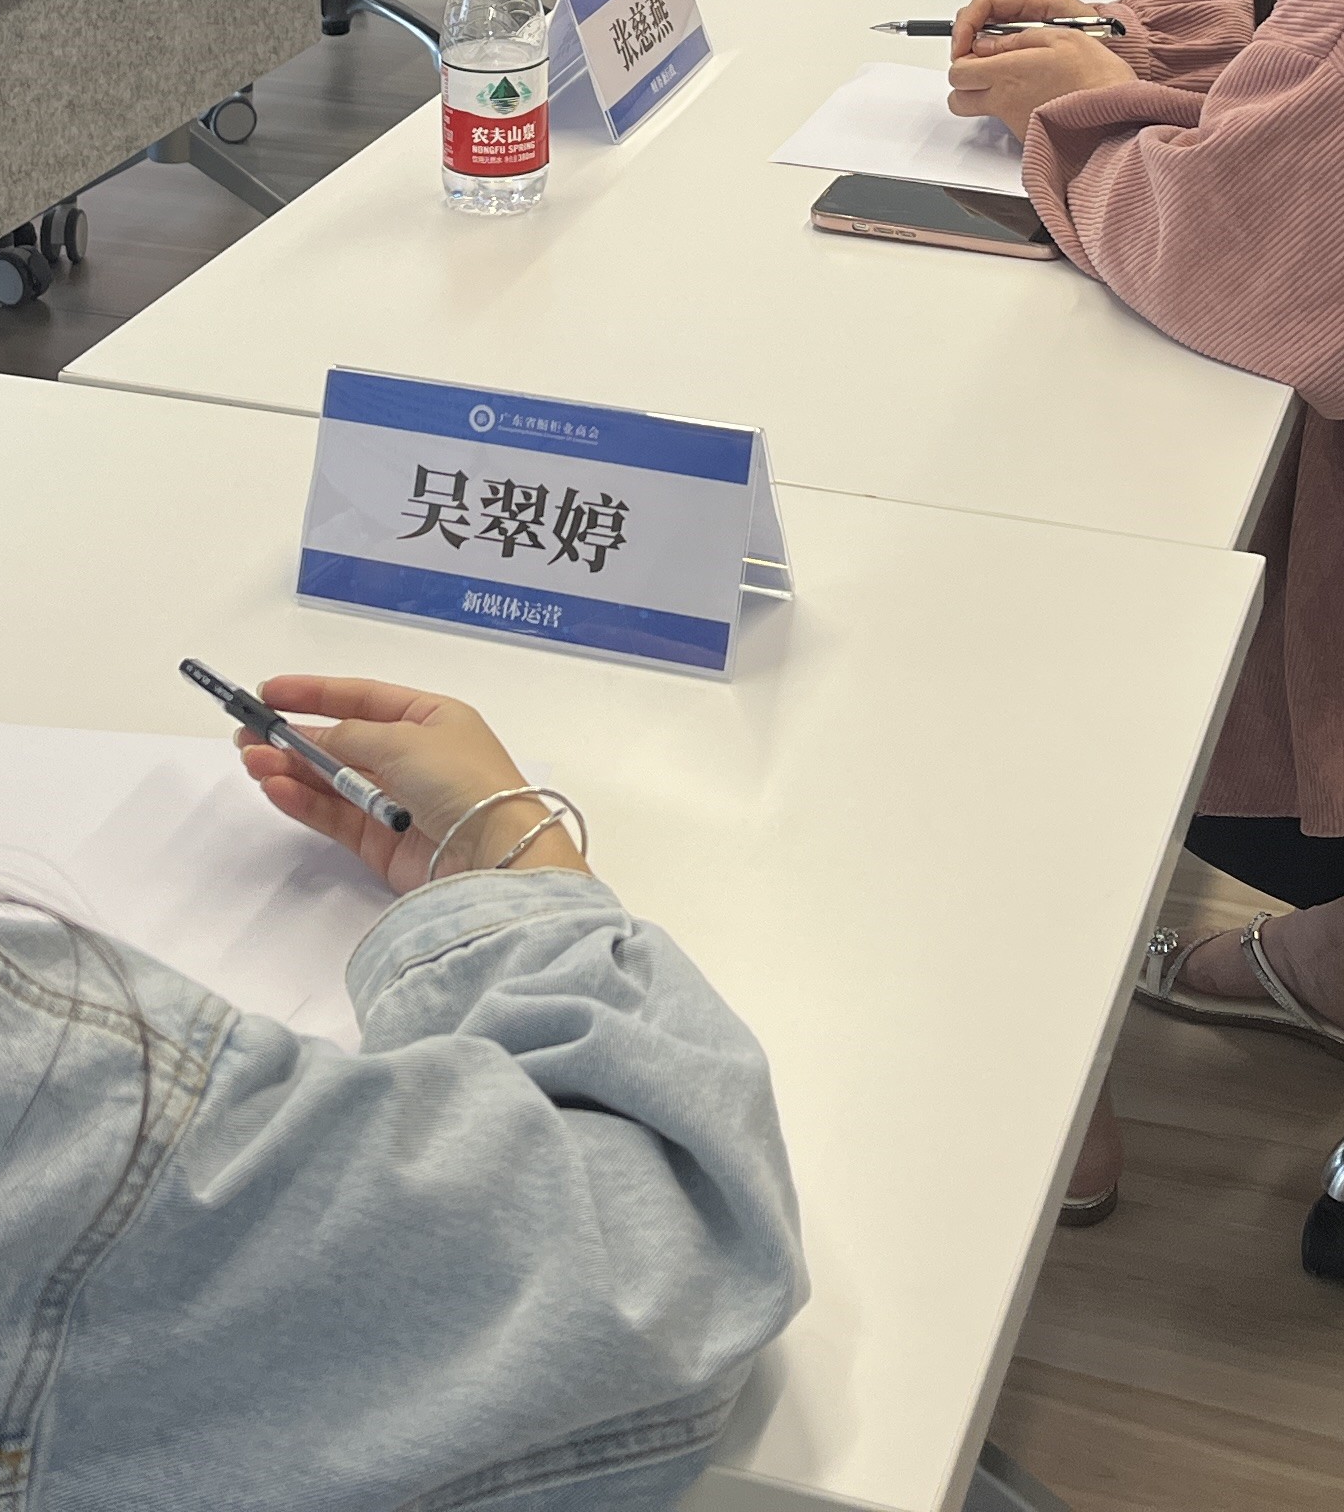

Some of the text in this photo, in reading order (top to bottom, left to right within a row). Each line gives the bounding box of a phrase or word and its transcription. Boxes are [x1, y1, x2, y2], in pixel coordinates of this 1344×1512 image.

[471, 122, 536, 145] 农夫山泉
[471, 144, 506, 155] NONGFU
[396, 463, 630, 574] 吴翠婷
[461, 589, 562, 628] 新媒体运营
